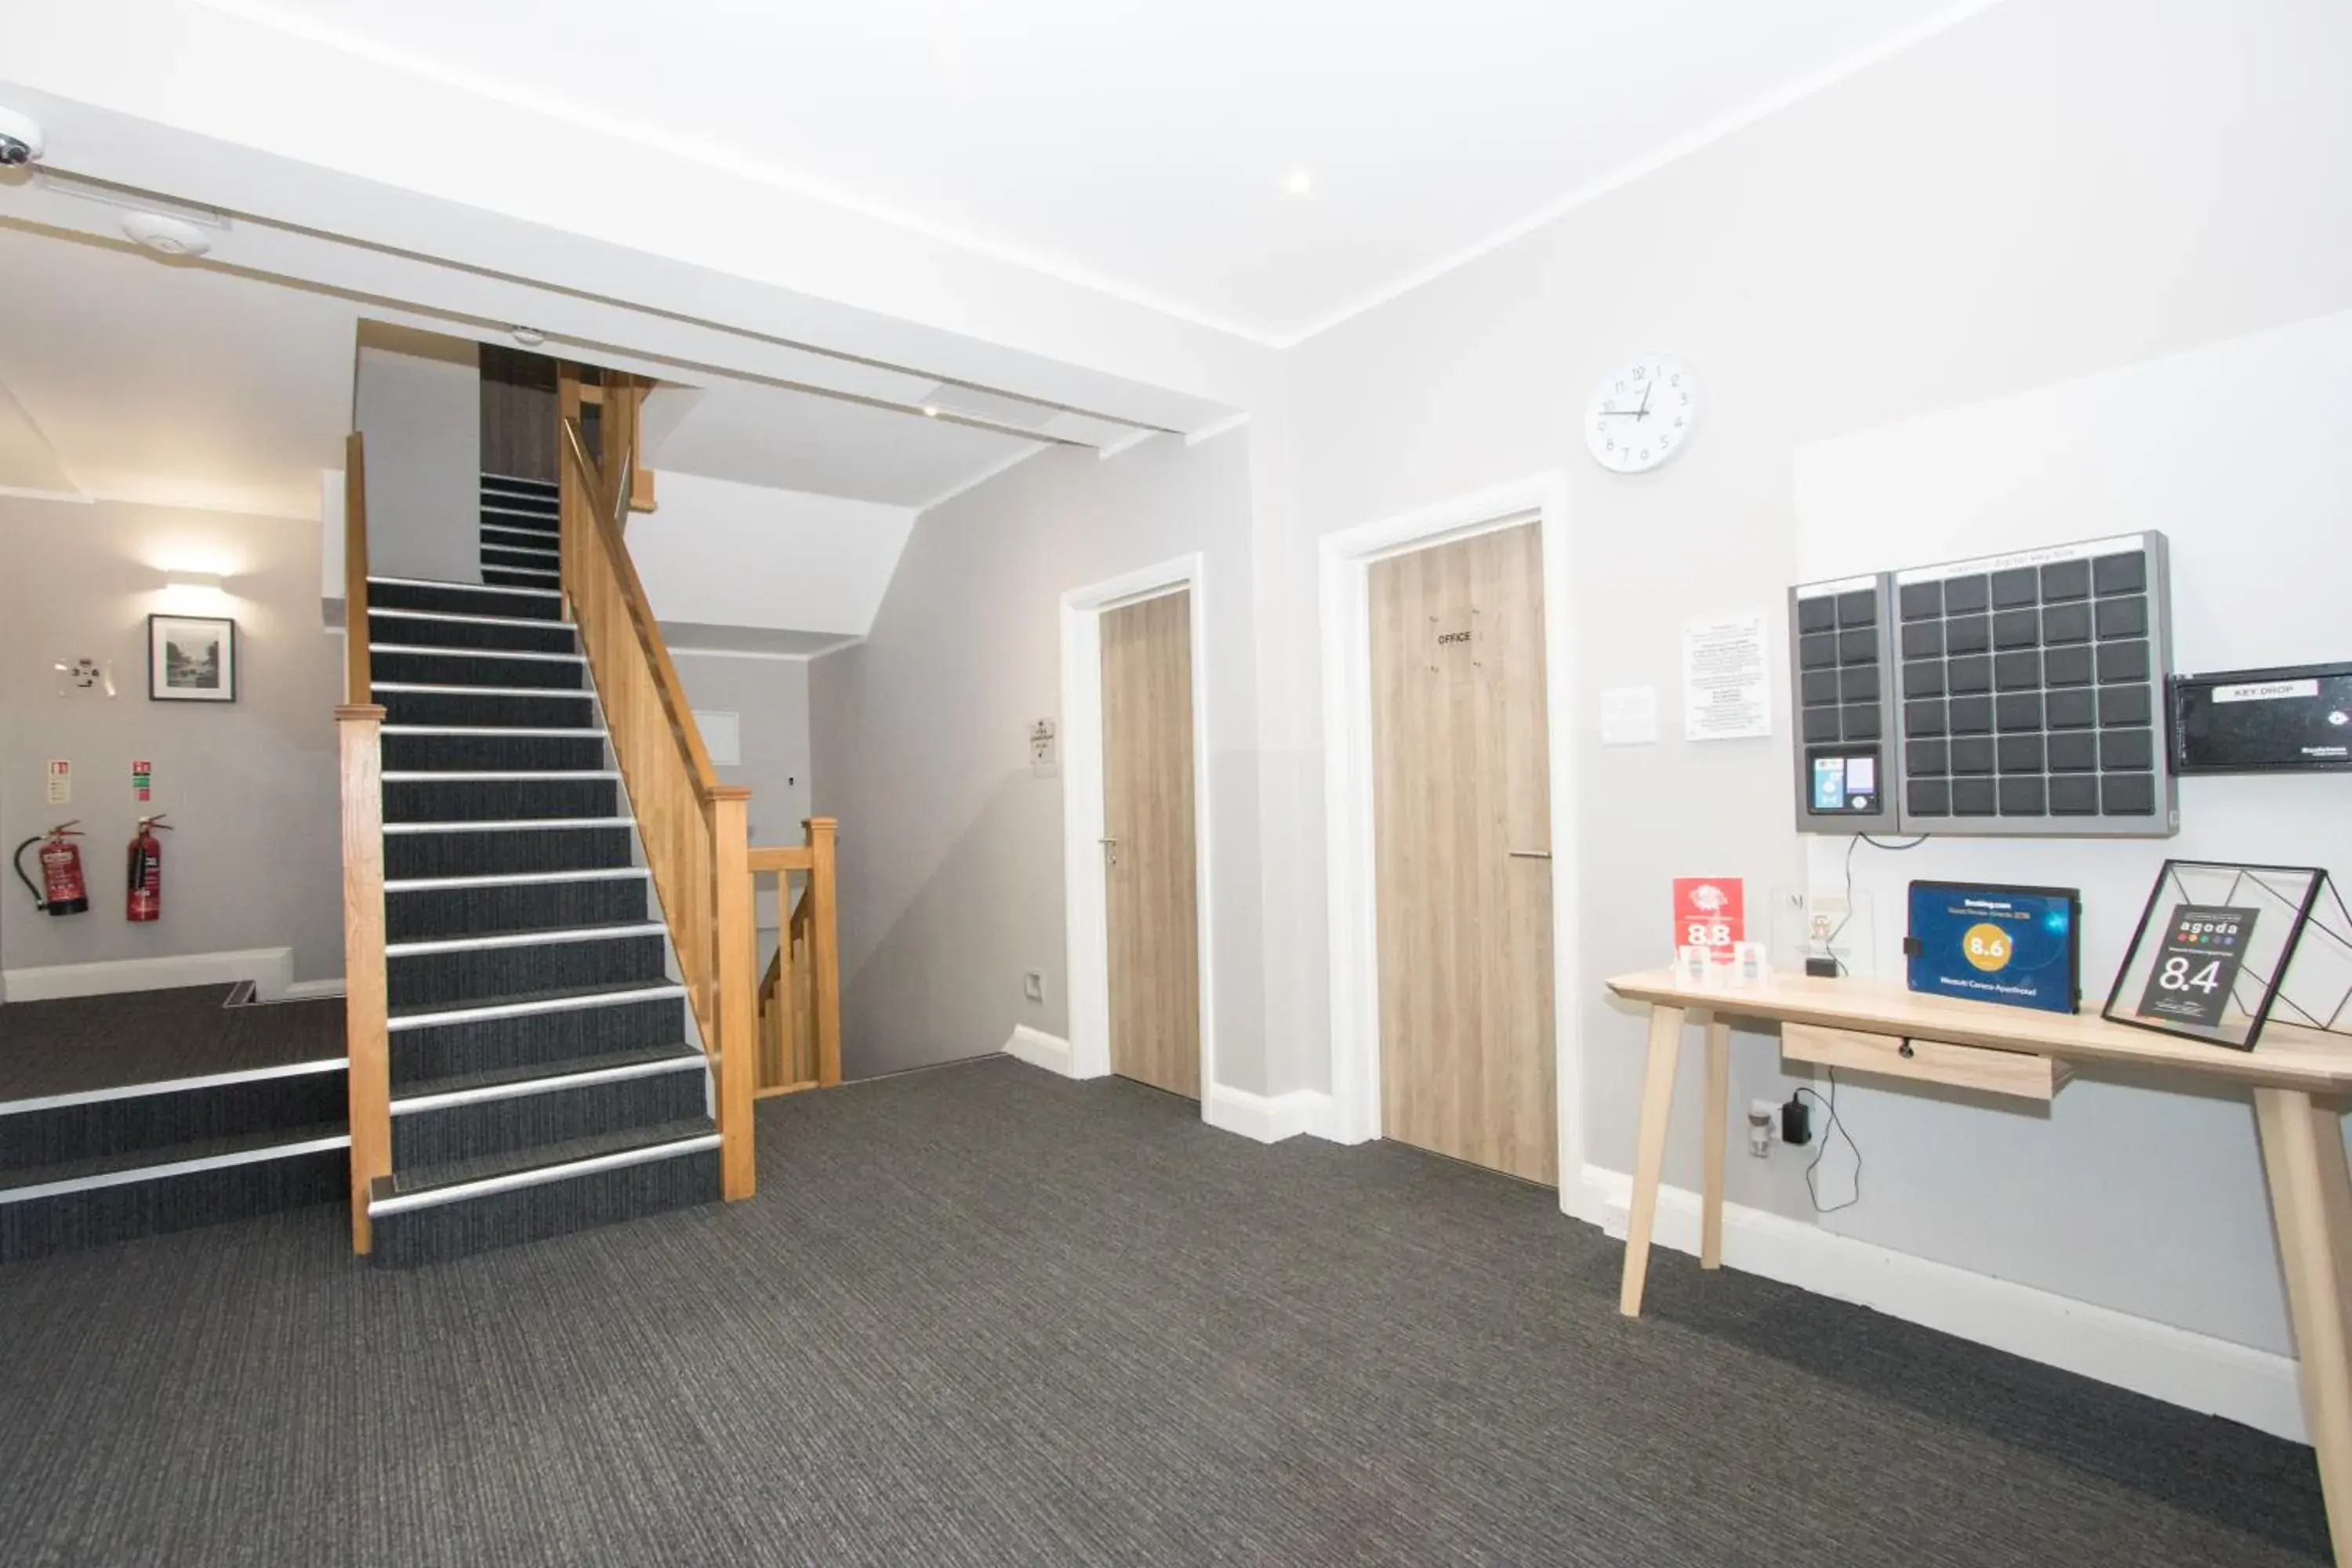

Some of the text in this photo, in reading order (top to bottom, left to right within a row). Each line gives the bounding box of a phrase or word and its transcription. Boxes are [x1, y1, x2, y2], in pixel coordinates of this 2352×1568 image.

[1632, 364, 1646, 380] 12
[1656, 365, 1661, 379] 1
[1671, 373, 1680, 387] 2
[1679, 392, 1688, 406] 3
[1598, 421, 1606, 433] 9
[1674, 416, 1682, 427] 4
[1606, 438, 1614, 451] 8
[1659, 434, 1669, 448] 5
[1622, 447, 1630, 462] 7
[1640, 448, 1649, 460] 6
[1438, 631, 1472, 644] OFFICE
[2260, 686, 2293, 695] DROP
[1687, 922, 1731, 946] 8.8
[2180, 921, 2238, 934] agoda
[1970, 937, 2004, 957] 8.6
[2159, 956, 2220, 994] 8.4
